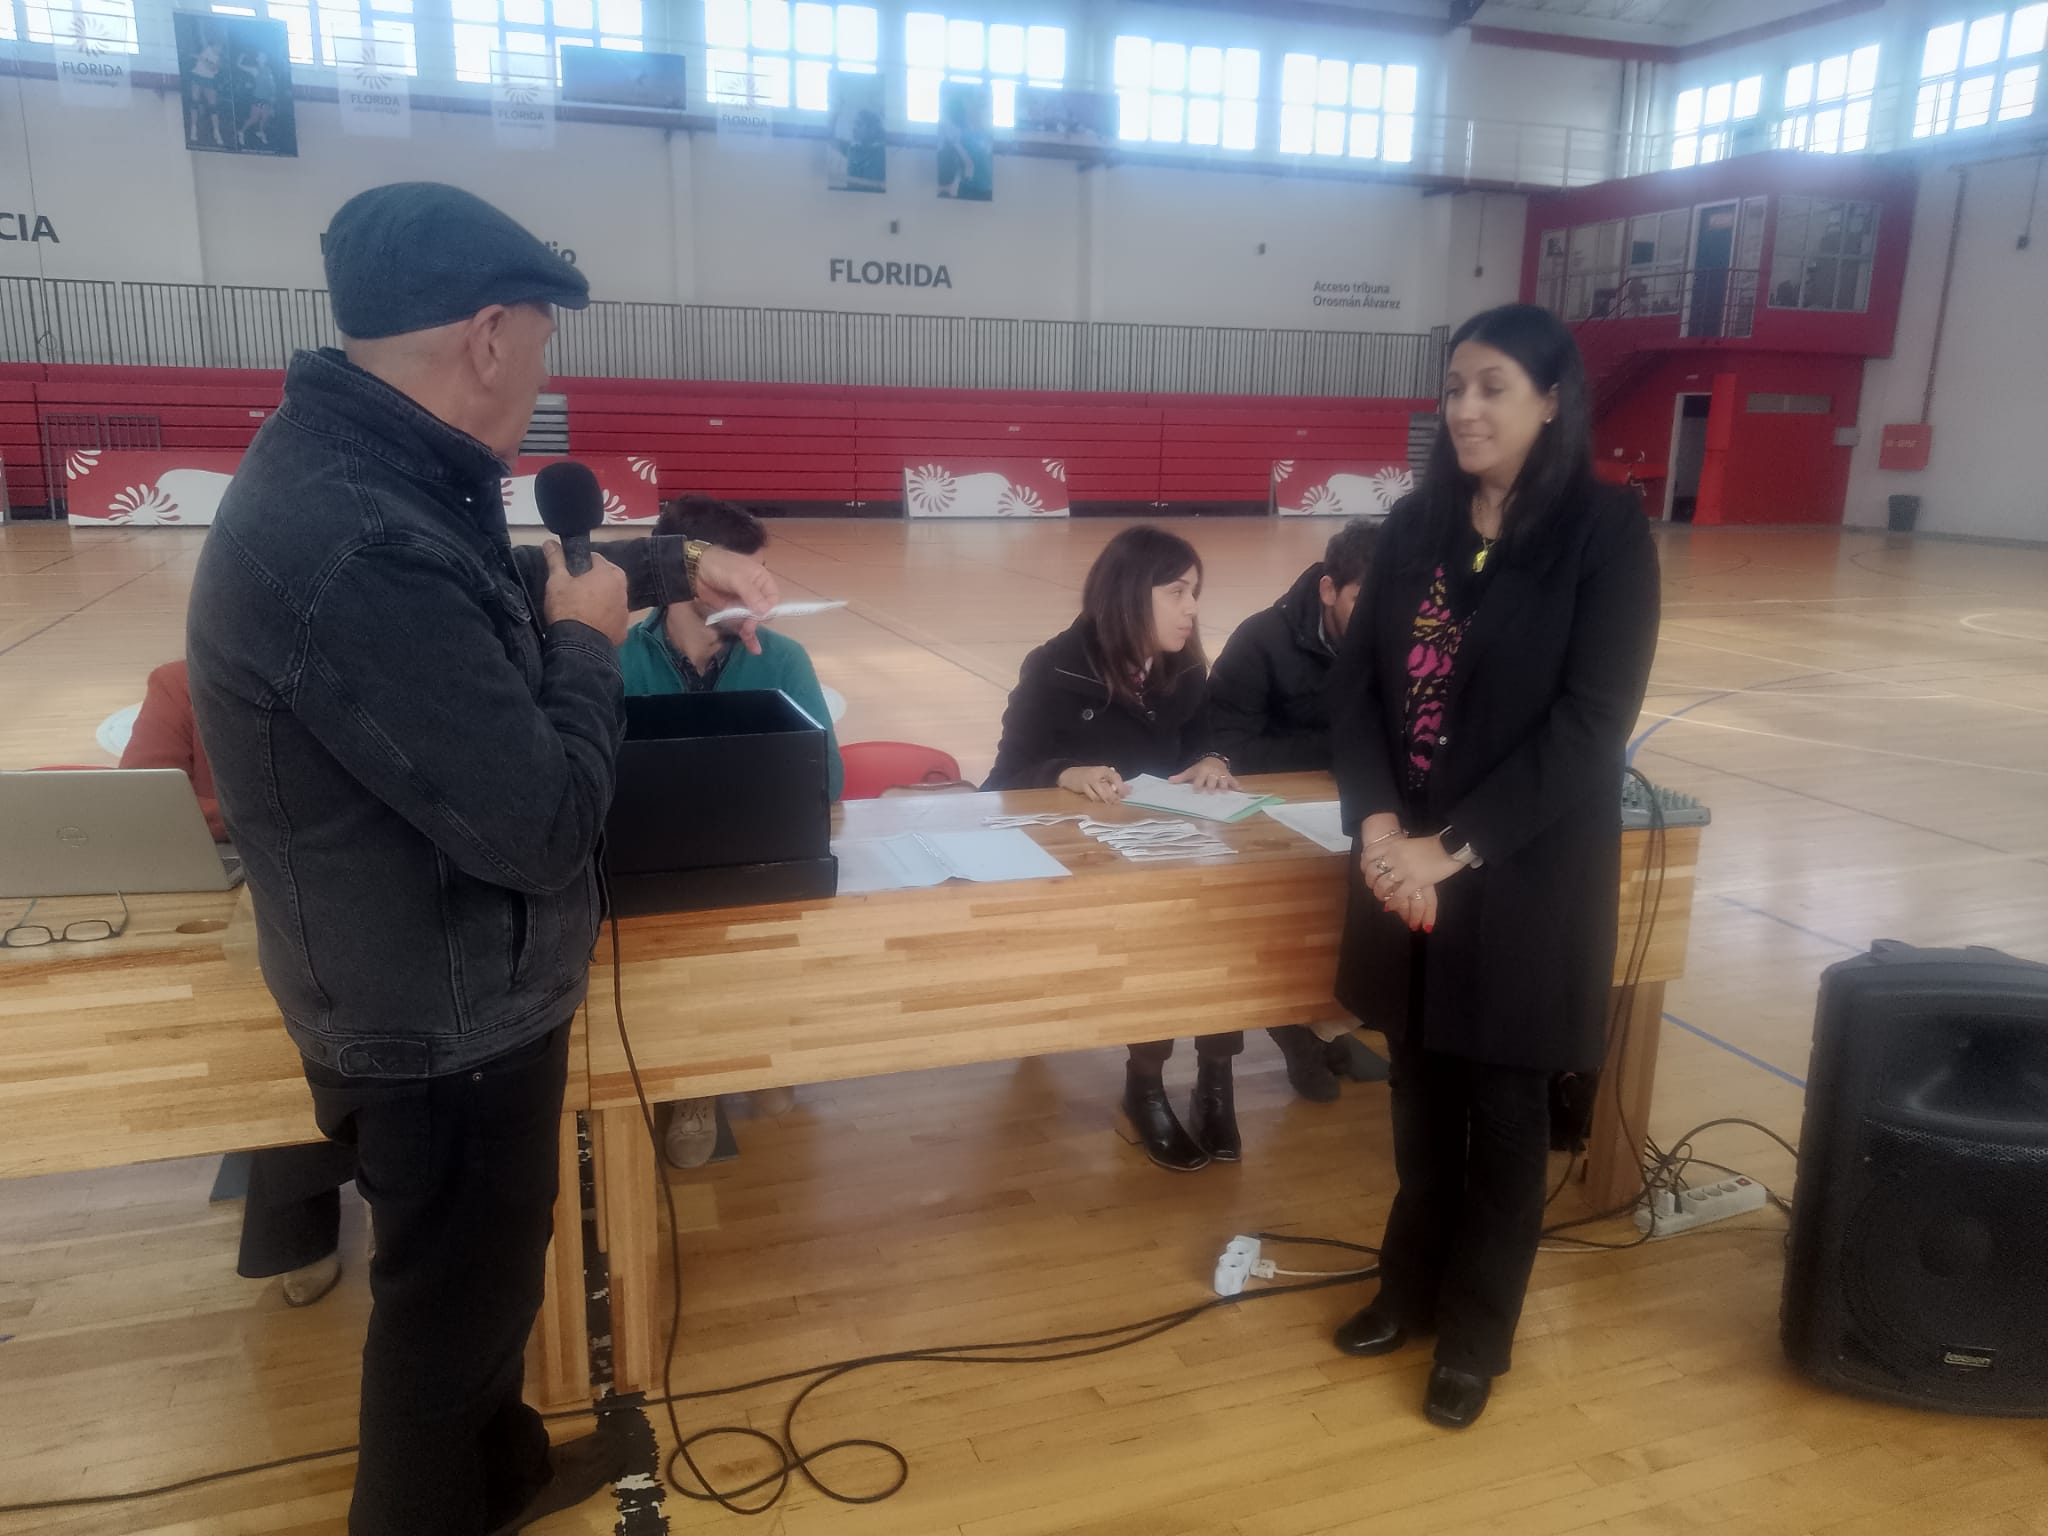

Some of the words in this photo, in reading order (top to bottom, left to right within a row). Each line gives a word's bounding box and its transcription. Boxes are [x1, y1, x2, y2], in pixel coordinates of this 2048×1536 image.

[62, 60, 124, 77] FLORIDA
[351, 94, 400, 106] FLORIDA
[498, 110, 544, 121] FLORIDA
[830, 258, 952, 288] FLORIDA
[1313, 280, 1350, 292] Acceso
[1353, 282, 1389, 294] tribuna
[1313, 295, 1360, 308] Orosmán
[1363, 295, 1400, 309] Álvarez
